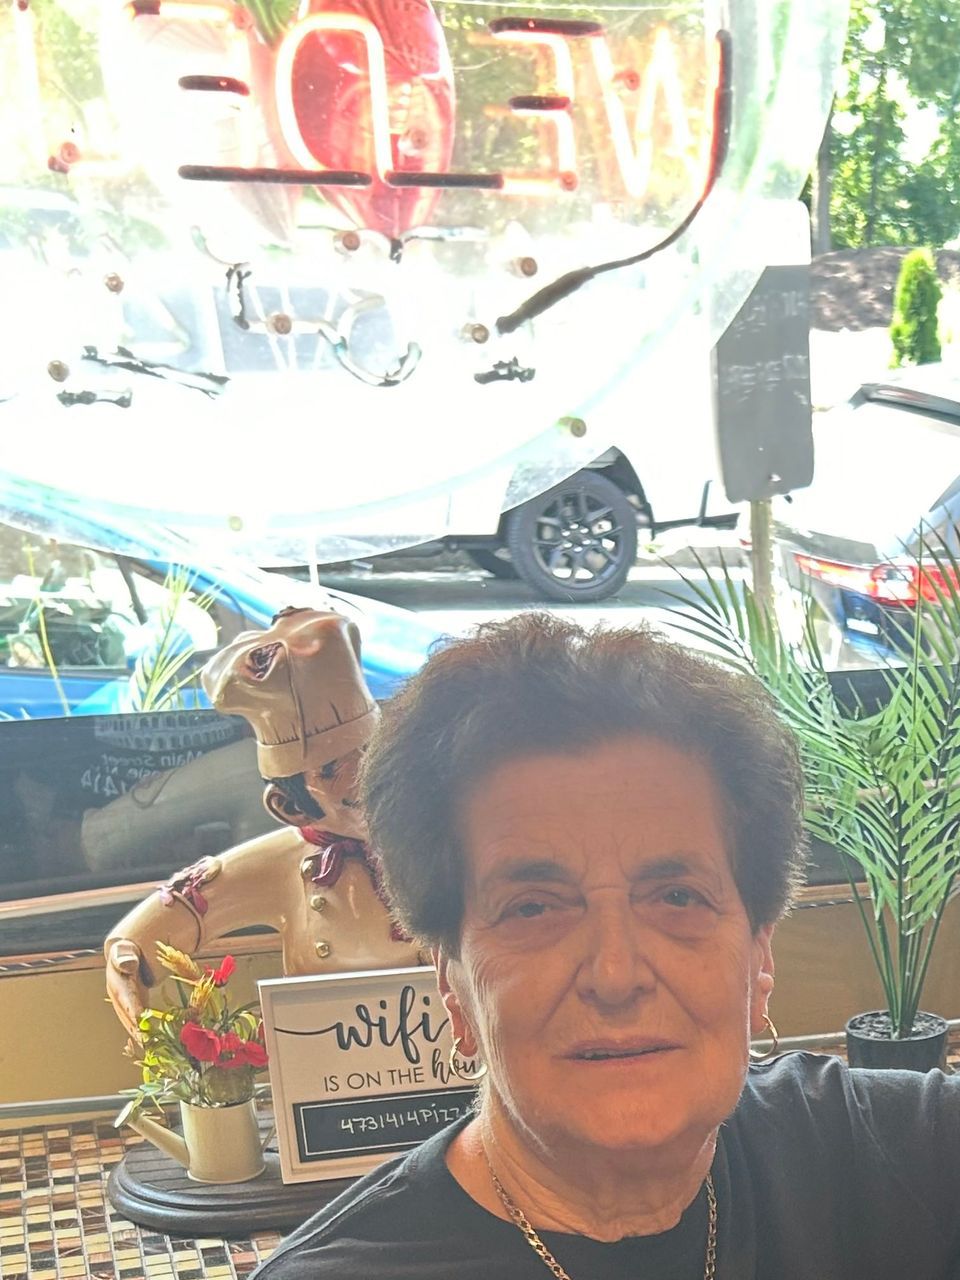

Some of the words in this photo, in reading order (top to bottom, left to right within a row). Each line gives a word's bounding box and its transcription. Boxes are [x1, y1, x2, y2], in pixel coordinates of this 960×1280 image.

[324, 1074, 340, 1092] IS
[347, 1070, 381, 1090] ON
[388, 1066, 425, 1086] THE
